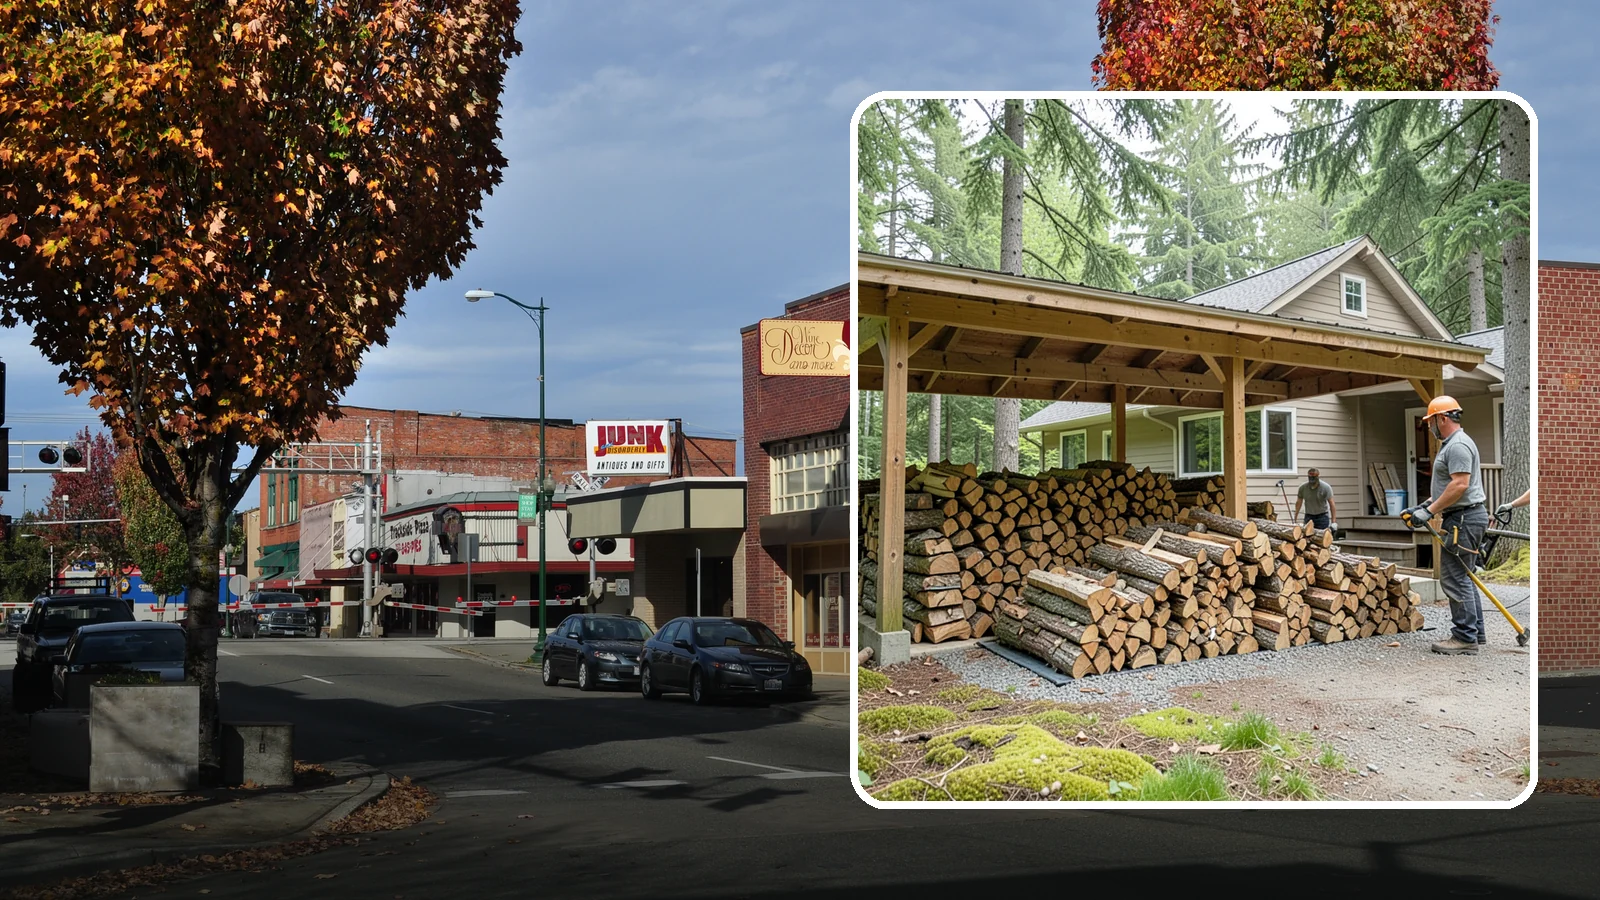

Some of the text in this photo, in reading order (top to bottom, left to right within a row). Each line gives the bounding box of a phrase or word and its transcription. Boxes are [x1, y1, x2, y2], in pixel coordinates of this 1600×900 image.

[595, 425, 665, 457] JUNK
[608, 446, 645, 454] DISORDERLY
[597, 460, 665, 470] ANTIQUES AND GIFTS
